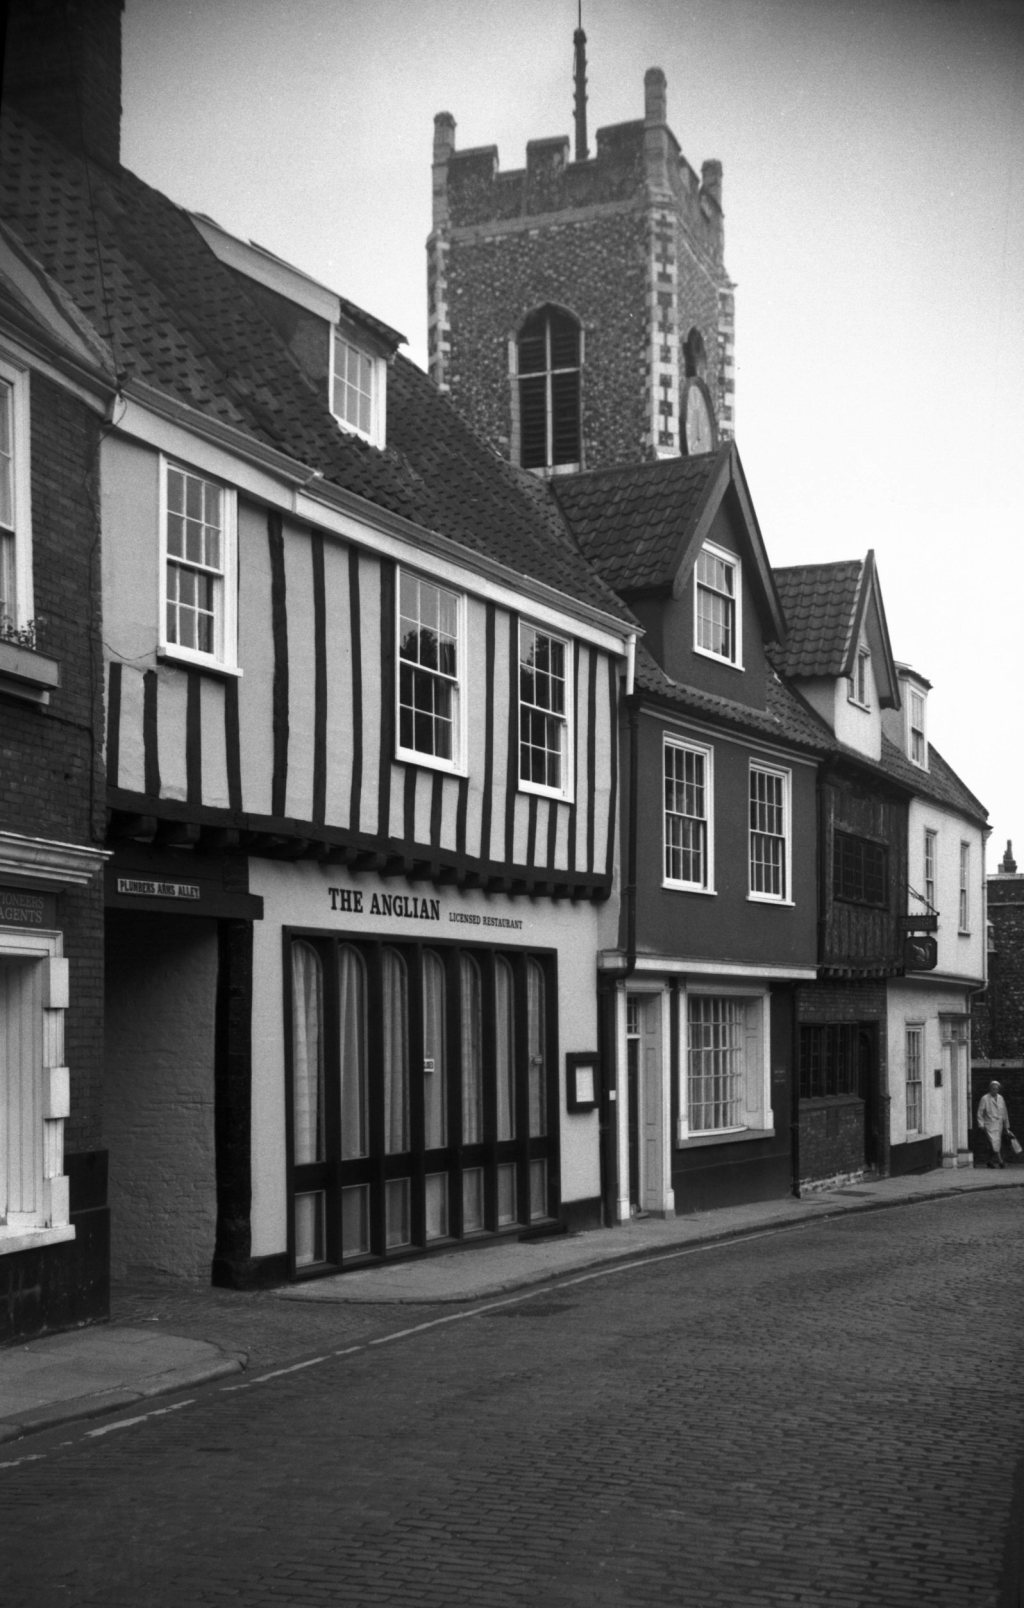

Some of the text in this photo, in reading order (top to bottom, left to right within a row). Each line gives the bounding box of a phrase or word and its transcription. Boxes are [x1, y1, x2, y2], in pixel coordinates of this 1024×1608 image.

[120, 880, 199, 898] PLUMBERS ARMS ALLEY
[328, 887, 440, 921] THE ANGLIAN
[448, 911, 523, 930] LICENSED RESTAURANT
